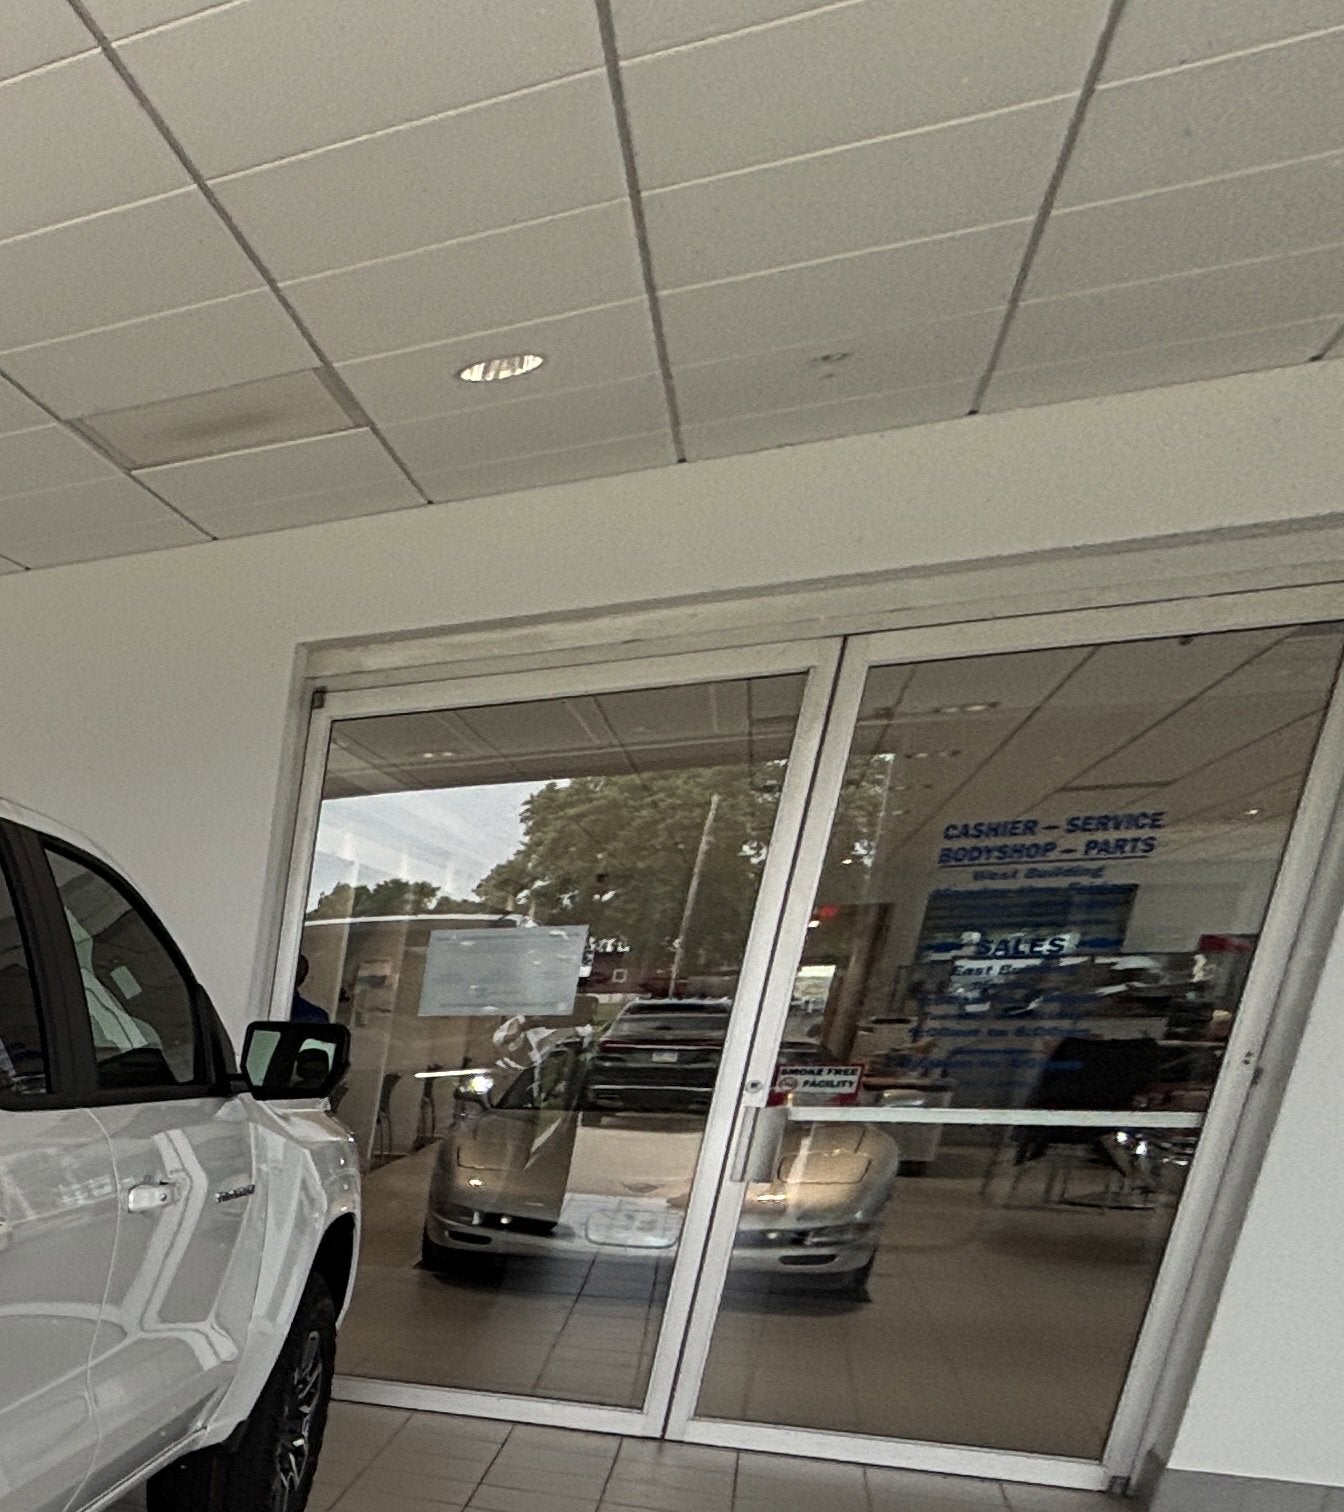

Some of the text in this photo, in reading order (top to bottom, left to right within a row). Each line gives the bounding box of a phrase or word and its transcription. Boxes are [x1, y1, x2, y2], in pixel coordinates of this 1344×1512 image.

[943, 818, 1039, 840] CASHIER
[1065, 812, 1165, 833] SERVICE
[937, 840, 1058, 865] BODYSHOP
[1083, 835, 1158, 856] PARTS
[972, 865, 1105, 882] West Building
[974, 936, 1067, 957] SALES
[780, 1067, 859, 1076] SMOKE FREE
[802, 1079, 855, 1089] FACILITY
